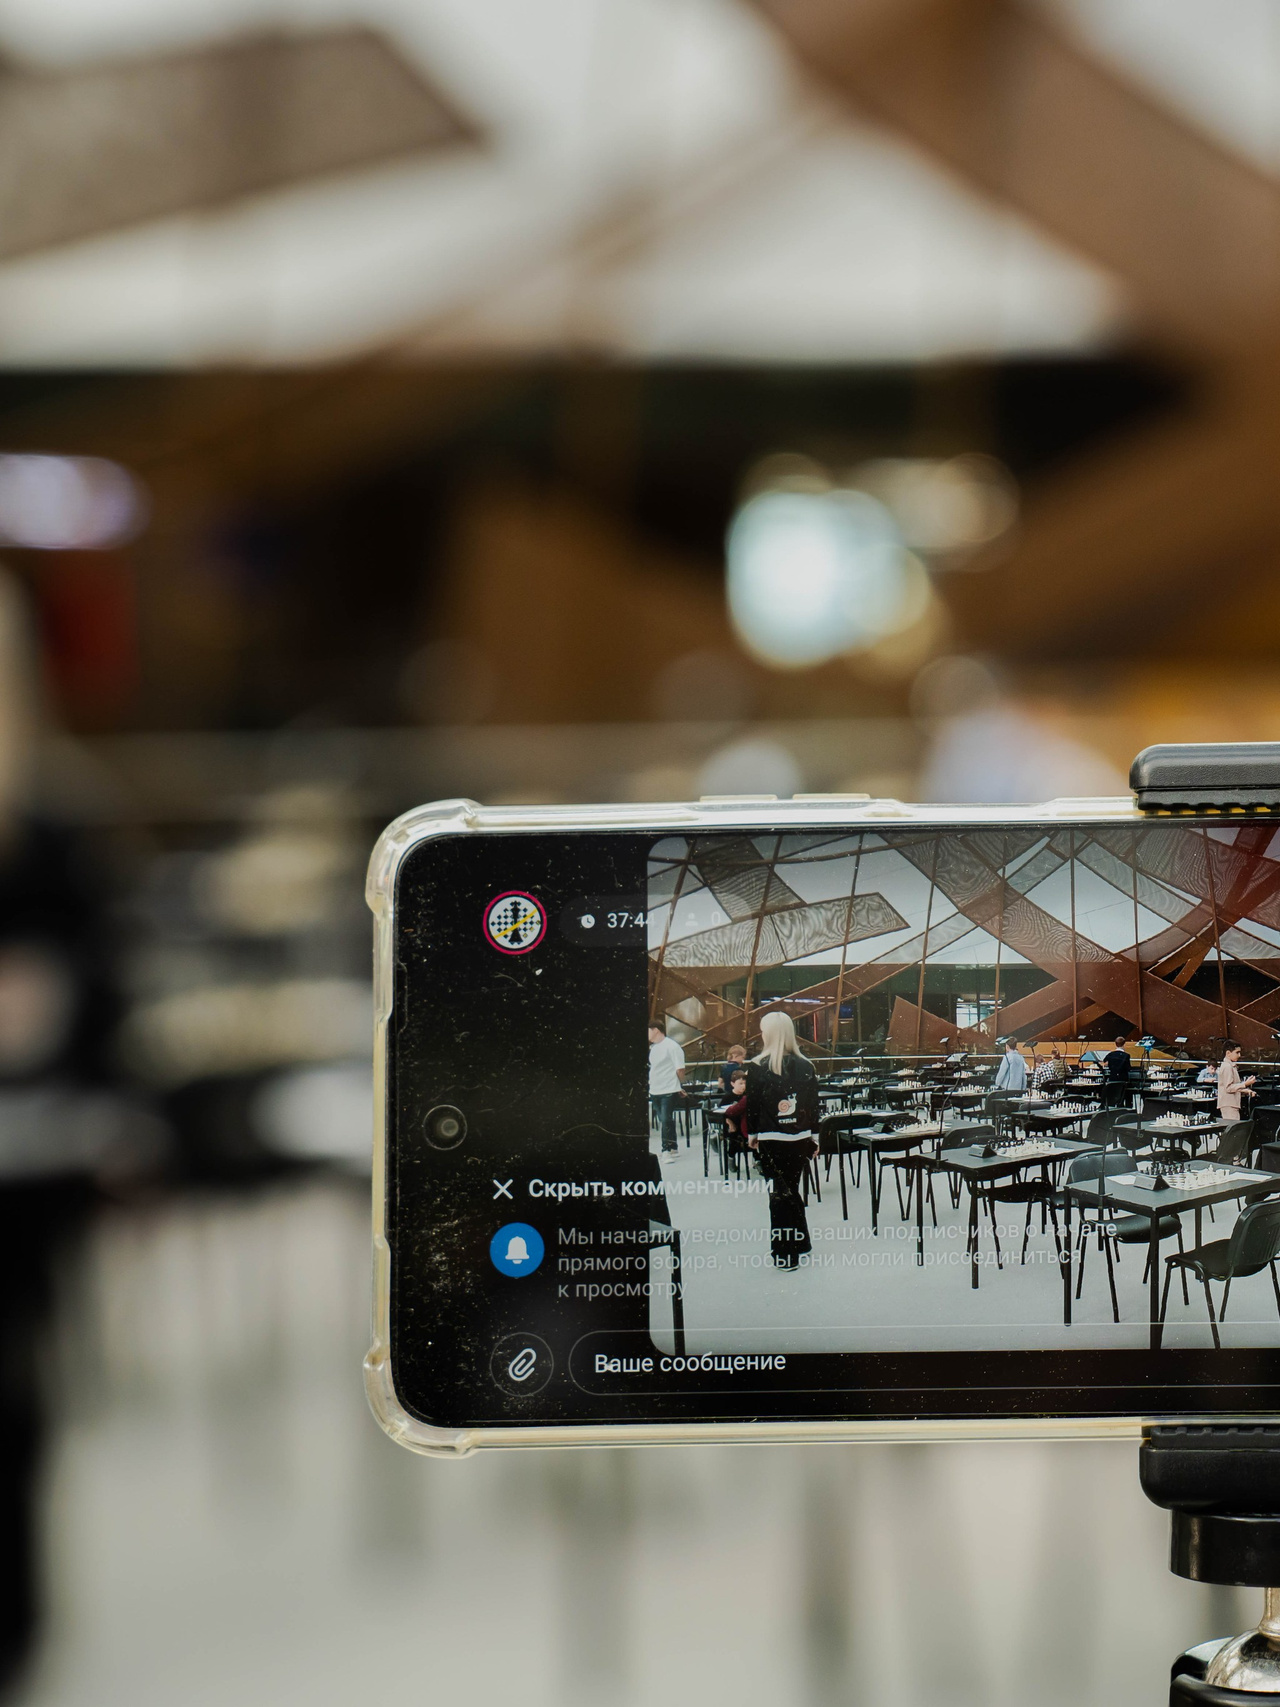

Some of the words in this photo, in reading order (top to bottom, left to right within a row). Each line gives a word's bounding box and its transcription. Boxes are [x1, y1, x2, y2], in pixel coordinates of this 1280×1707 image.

[607, 912, 655, 928] 37:44
[528, 1178, 615, 1201] Скрыть
[621, 1177, 774, 1197] комментарии
[558, 1228, 593, 1244] Мы
[600, 1228, 675, 1244] начали
[679, 1227, 805, 1246] уведомлять
[813, 1224, 878, 1240] ваших
[884, 1222, 1019, 1243] подписчиков
[1046, 1220, 1117, 1237] начале
[558, 1255, 646, 1275] прямого
[653, 1252, 722, 1273] эфира,
[728, 1250, 798, 1268] чтобы
[800, 1252, 835, 1267] они
[842, 1251, 903, 1267] могли
[911, 1248, 1081, 1269] присоединиться
[558, 1284, 569, 1298] к
[576, 1279, 687, 1301] просмотру
[595, 1354, 653, 1373] Ваше
[660, 1351, 786, 1375] сообщение
